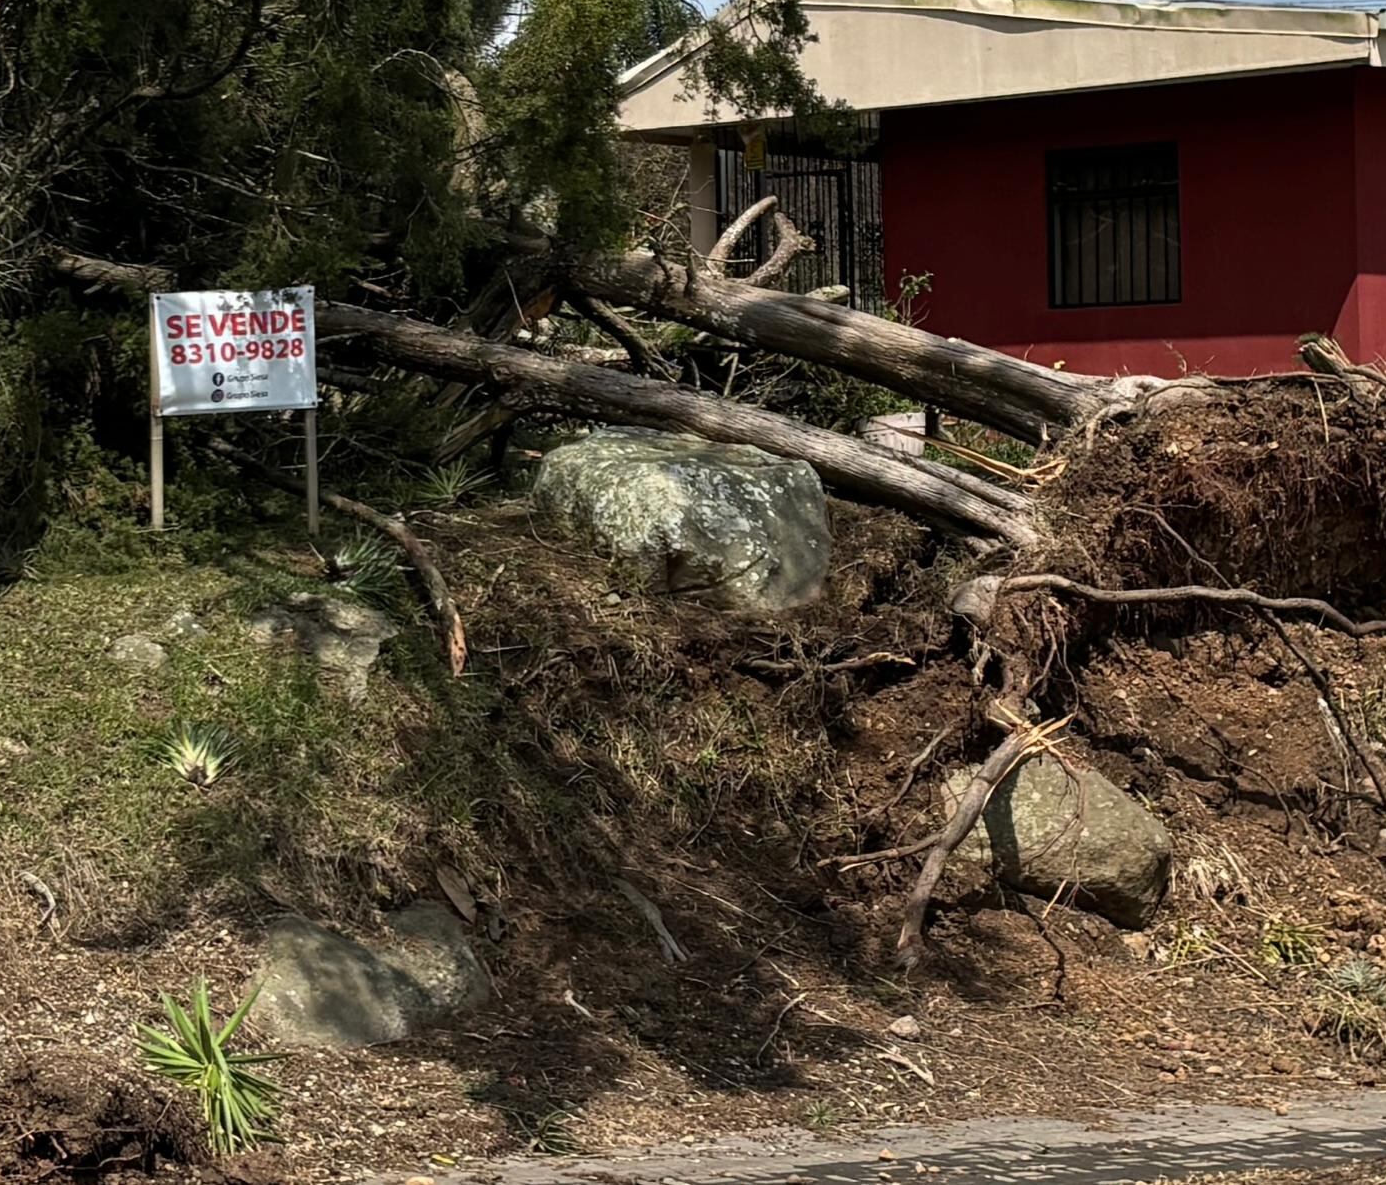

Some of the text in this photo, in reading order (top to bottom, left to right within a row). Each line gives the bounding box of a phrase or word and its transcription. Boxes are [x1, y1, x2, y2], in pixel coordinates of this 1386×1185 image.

[166, 309, 306, 339] SE VENDE
[171, 338, 304, 364] 8310-9828
